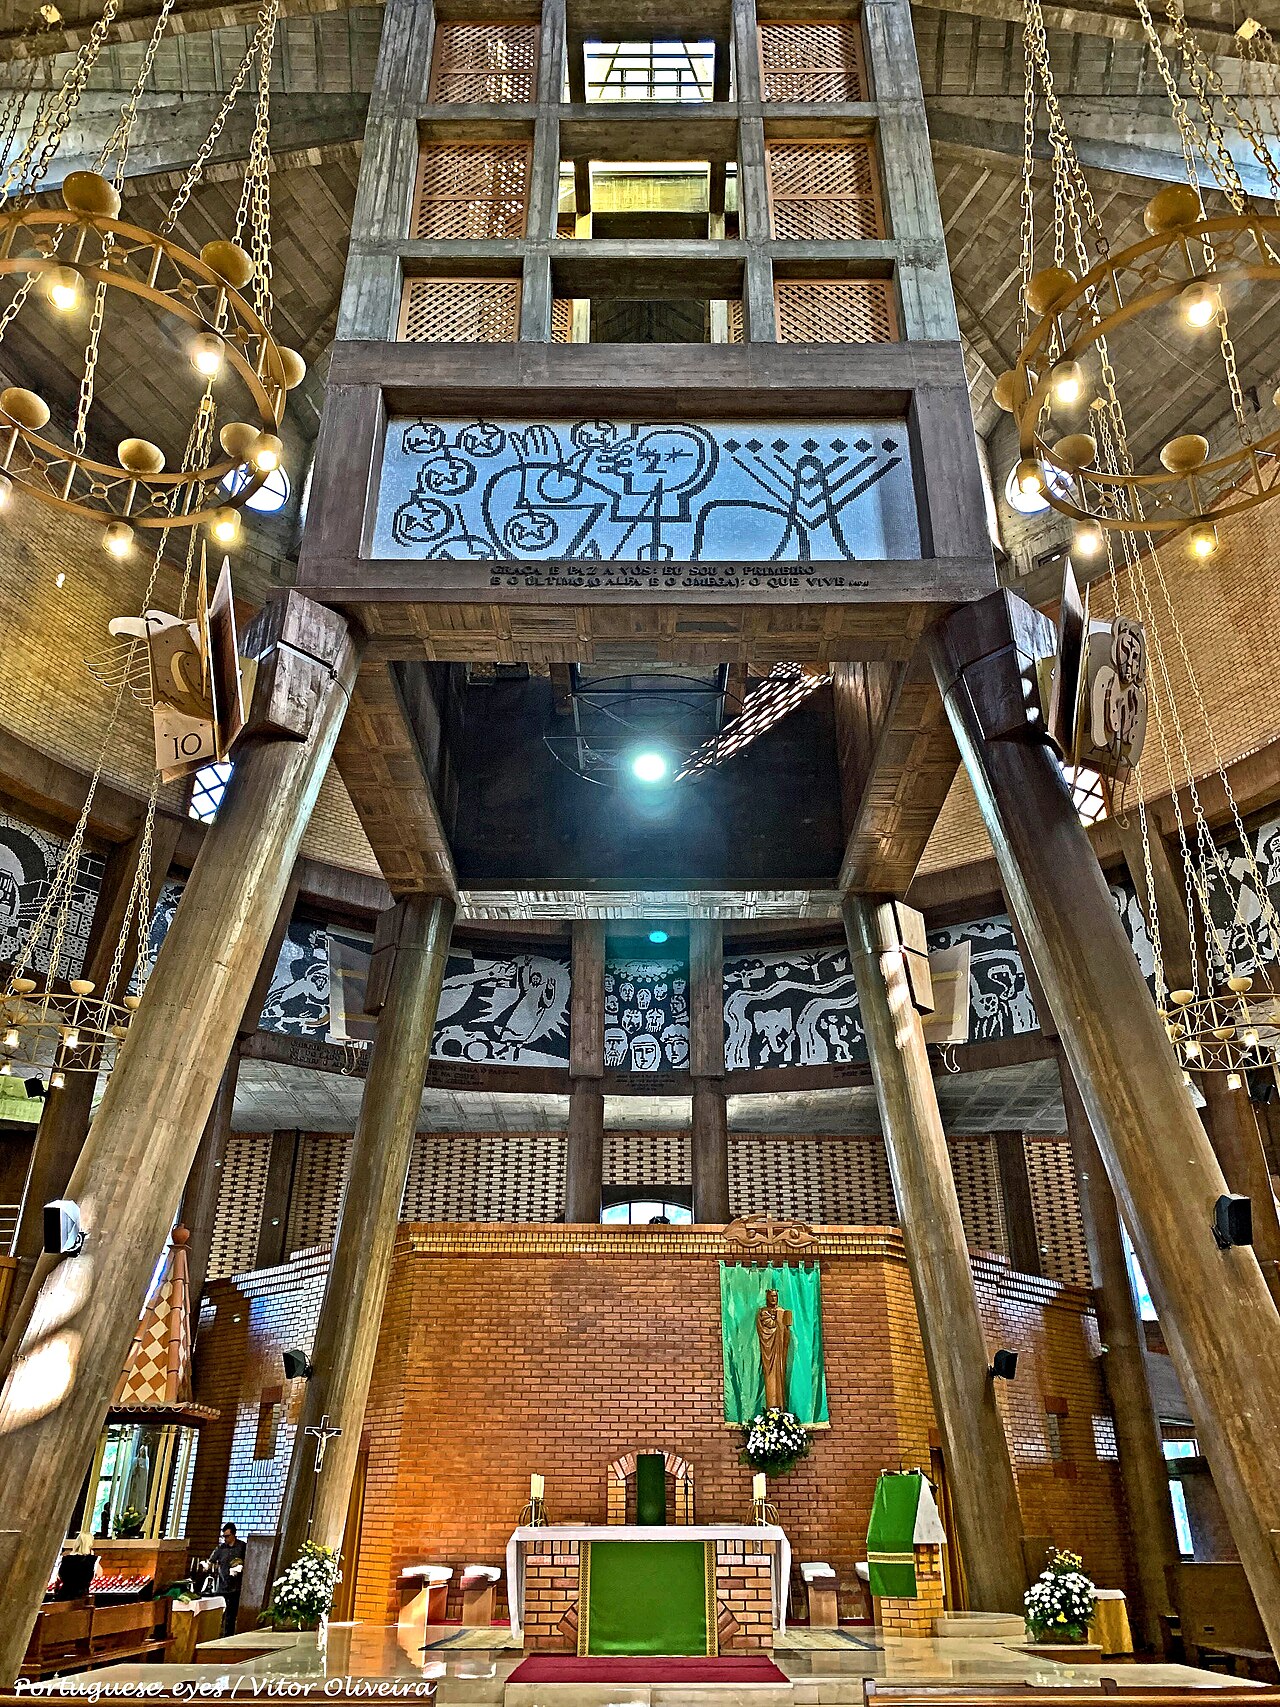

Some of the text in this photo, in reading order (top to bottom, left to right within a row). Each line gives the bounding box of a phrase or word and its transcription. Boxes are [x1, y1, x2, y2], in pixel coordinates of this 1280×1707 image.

[549, 566, 560, 575] E
[567, 566, 598, 576] PAZ
[602, 567, 615, 576] A
[662, 566, 683, 576] EU
[688, 566, 718, 576] SOU
[723, 566, 737, 576] O
[742, 565, 817, 576] PRIMEIRO
[489, 577, 502, 586] E
[506, 577, 520, 586] O
[604, 577, 643, 587] ALFA
[649, 578, 660, 587] E
[664, 577, 677, 587] O
[748, 577, 761, 587] O
[766, 577, 800, 589] QUE
[805, 577, 845, 588] VIVE
